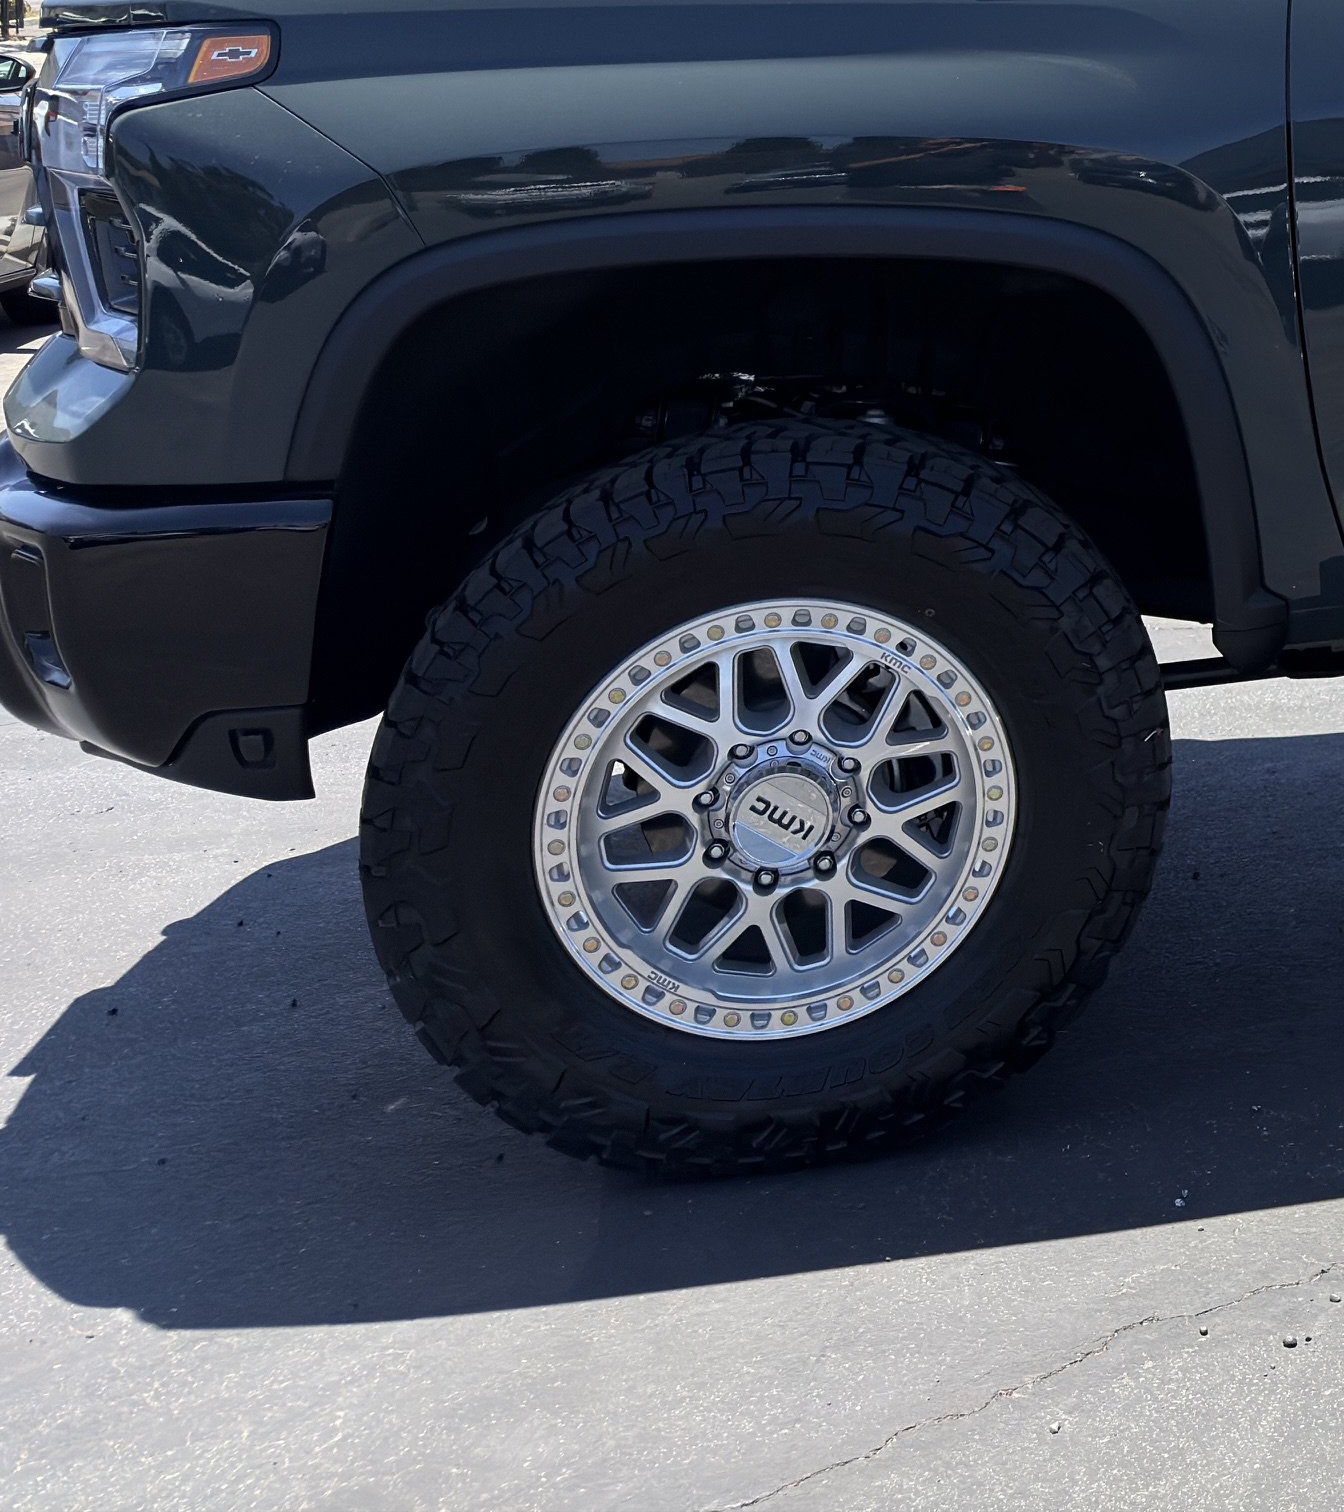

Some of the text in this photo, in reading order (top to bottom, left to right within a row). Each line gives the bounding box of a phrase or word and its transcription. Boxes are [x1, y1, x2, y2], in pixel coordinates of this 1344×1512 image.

[880, 651, 912, 675] KMC
[749, 795, 815, 841] KMC
[647, 970, 681, 993] KMC
